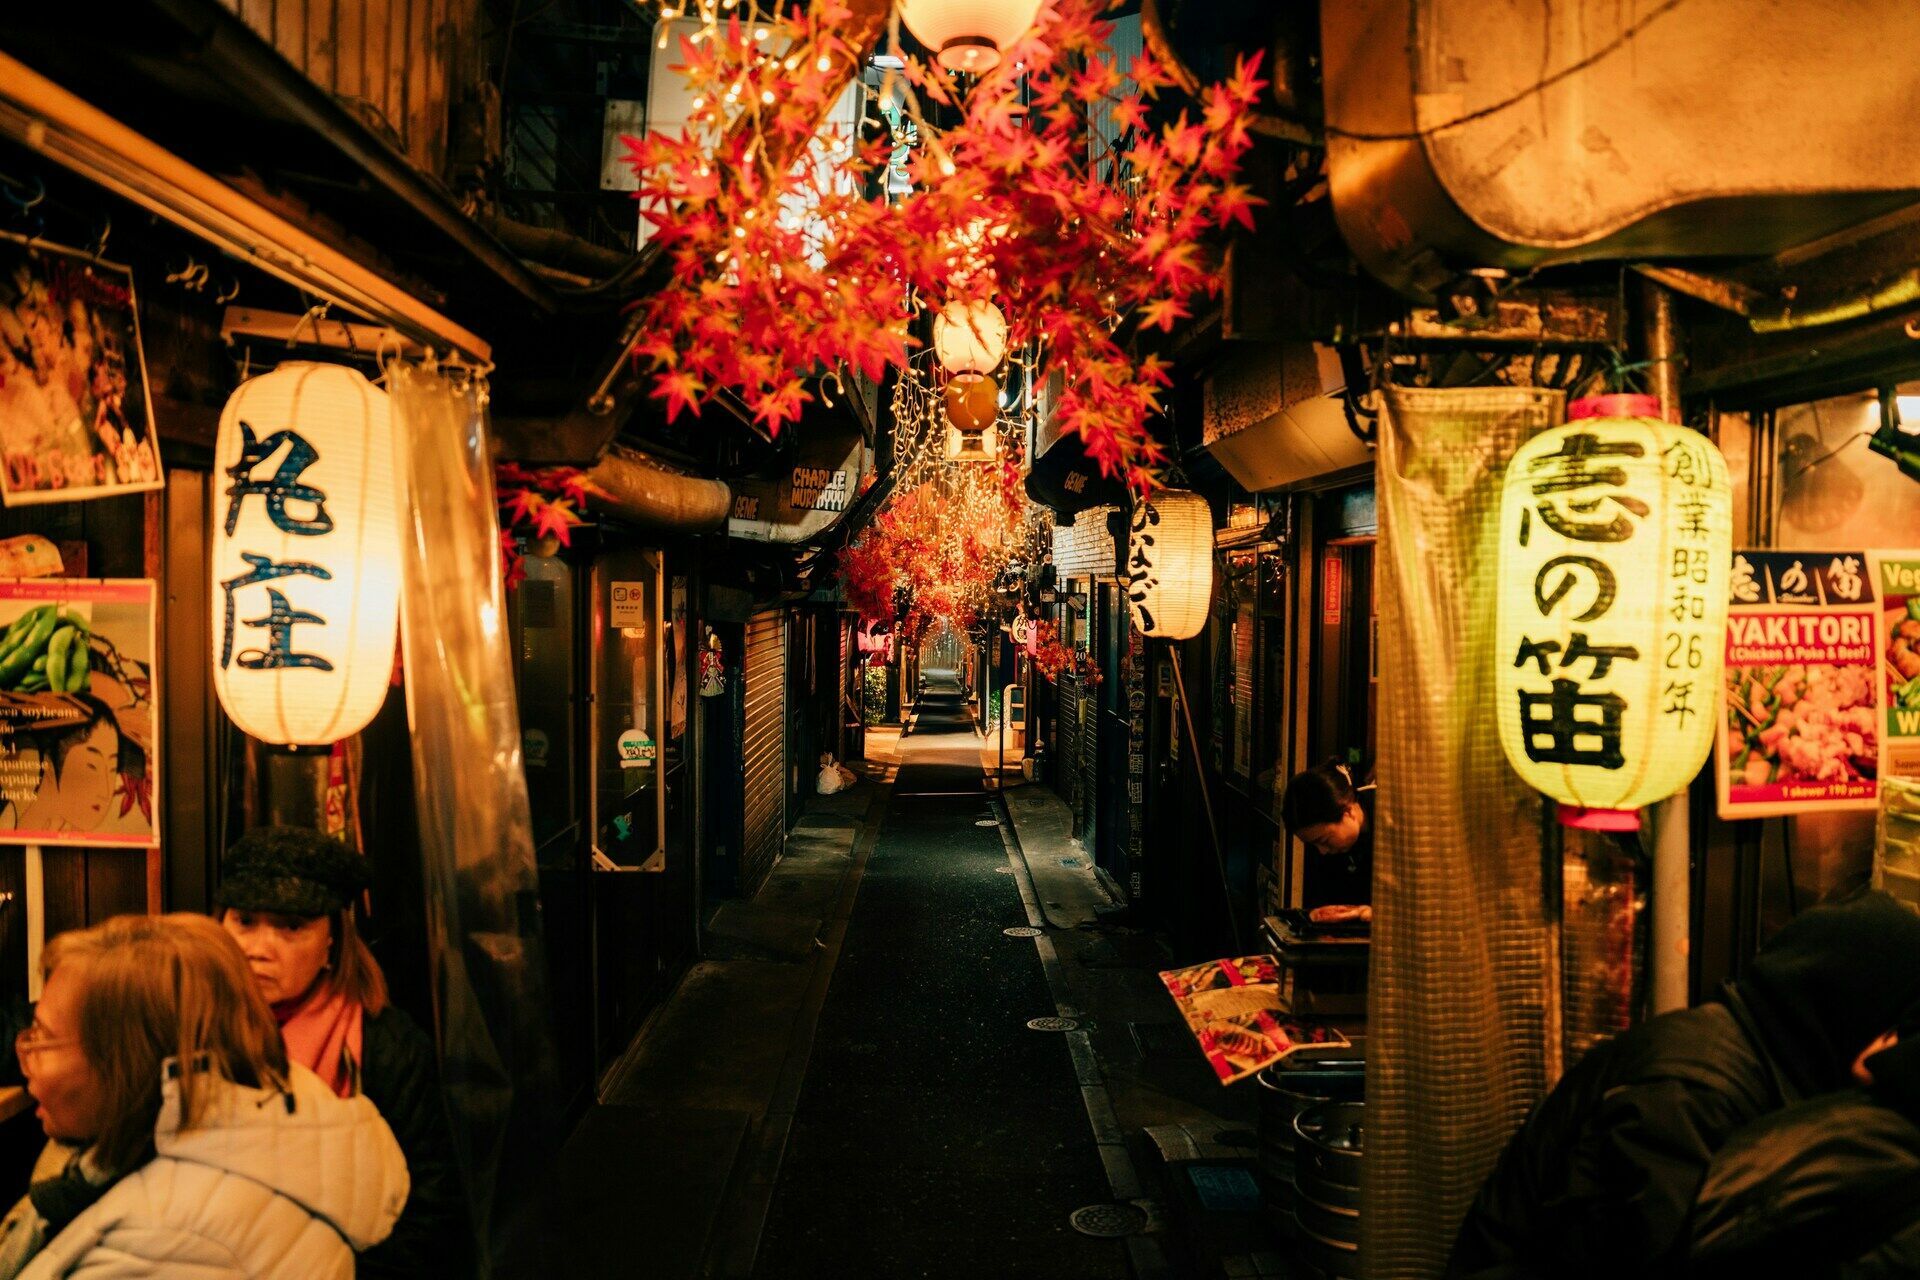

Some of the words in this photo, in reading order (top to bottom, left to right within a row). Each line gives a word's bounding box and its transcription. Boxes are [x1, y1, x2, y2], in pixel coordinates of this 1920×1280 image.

[1514, 433, 1650, 769] 志の笛
[1728, 615, 1870, 646] YAKITORI
[22, 705, 79, 719] soybeans
